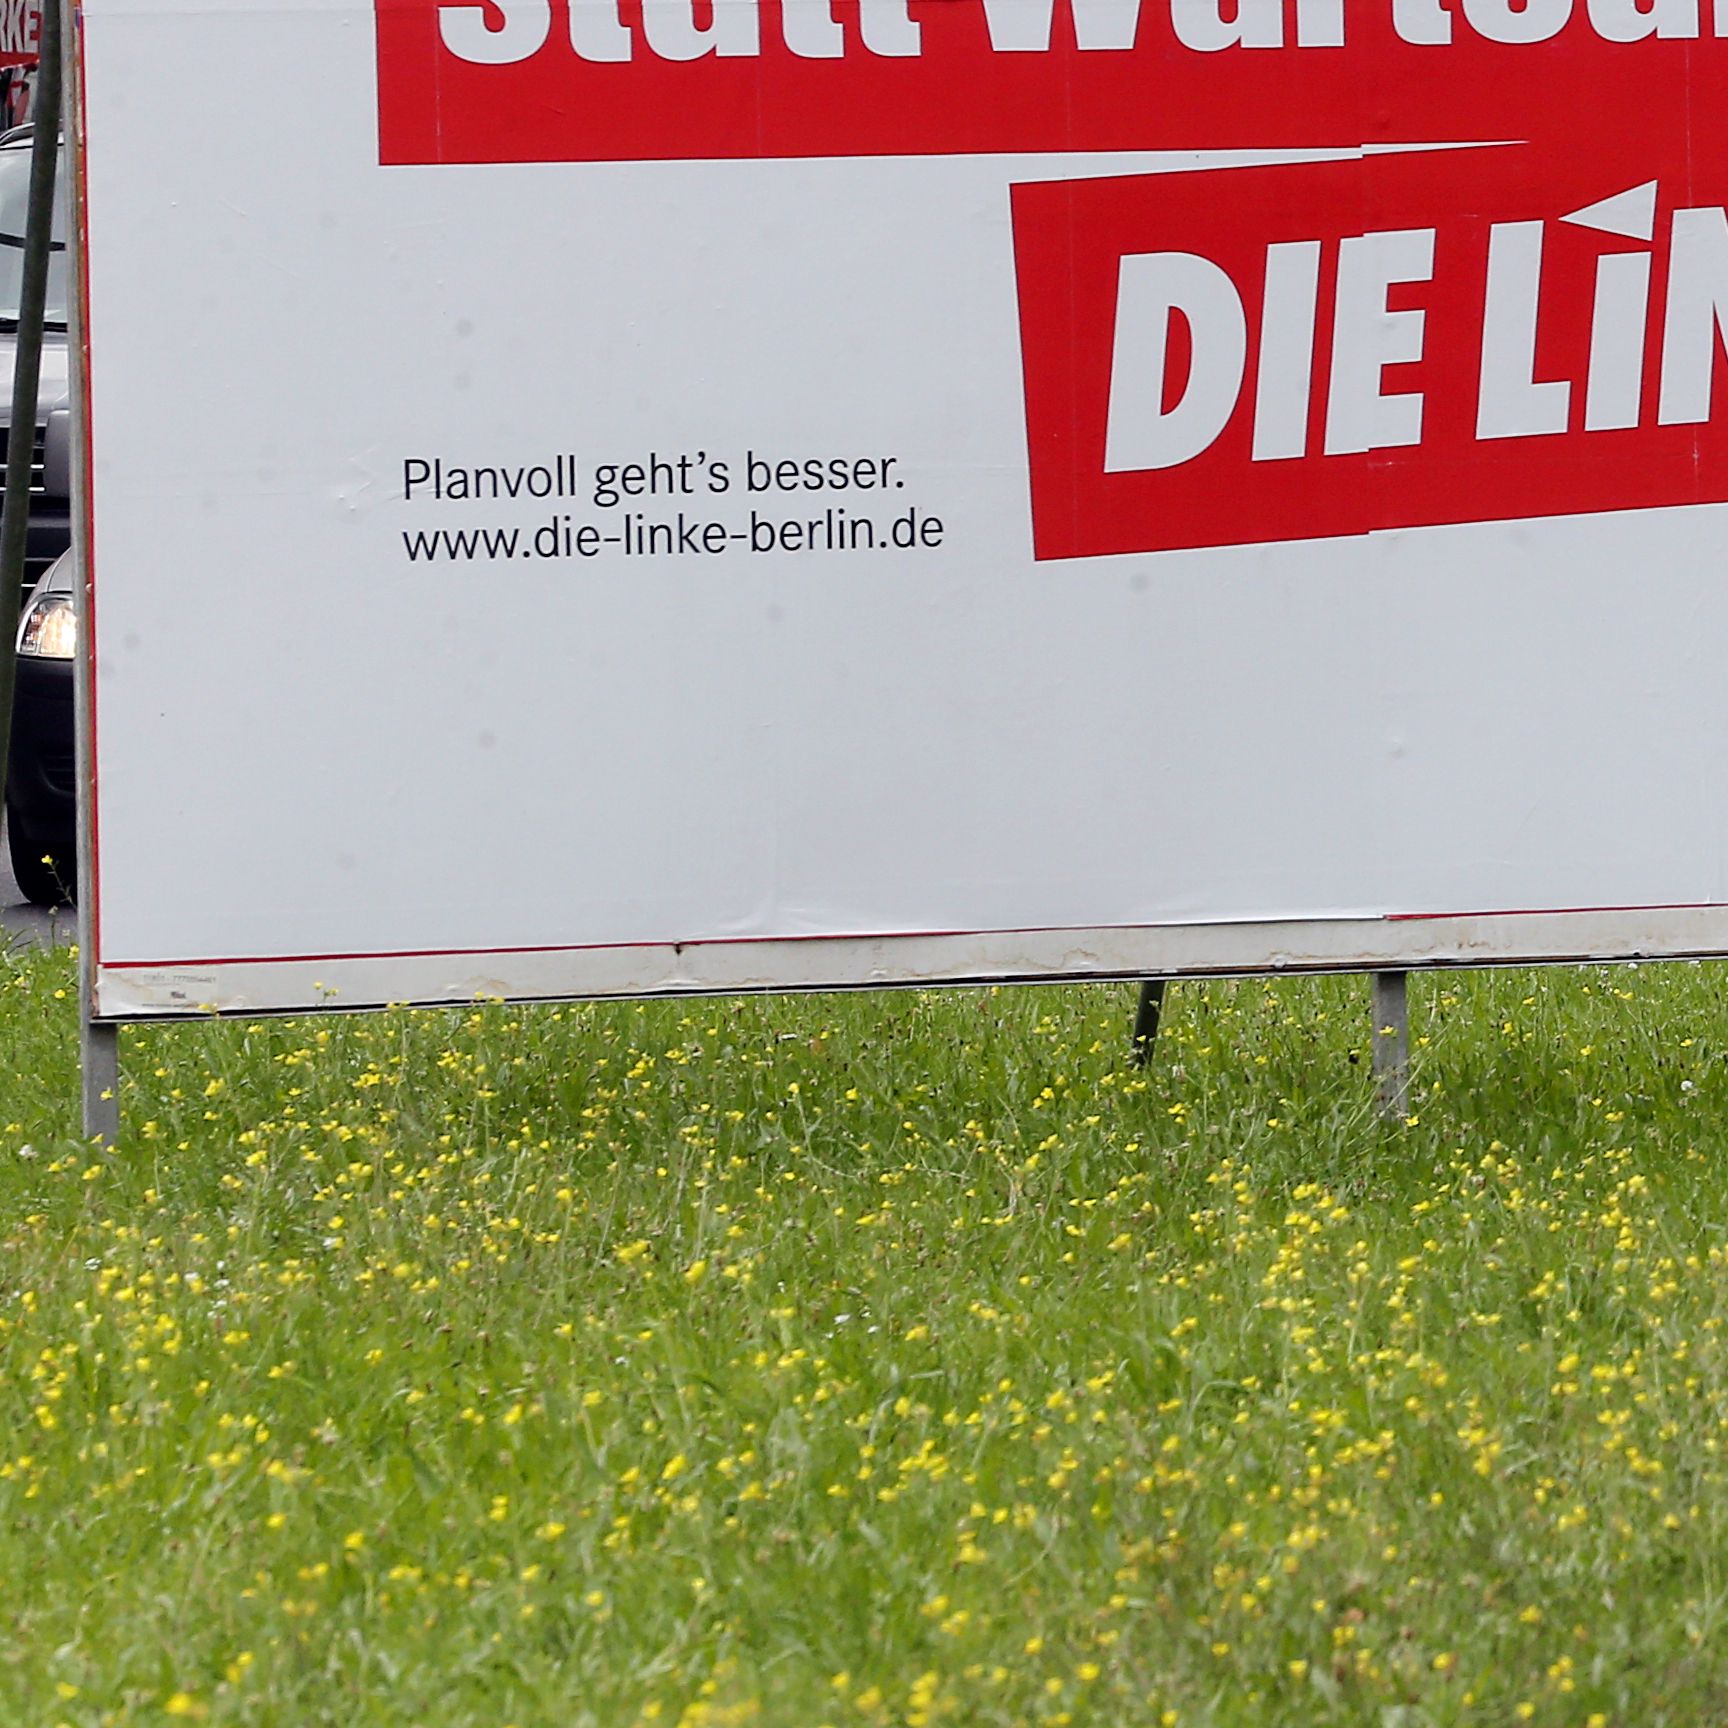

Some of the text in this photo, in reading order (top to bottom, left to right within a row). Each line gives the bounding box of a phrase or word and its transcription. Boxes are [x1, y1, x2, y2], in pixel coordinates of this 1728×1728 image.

[1103, 228, 1435, 473] DIE
[403, 450, 904, 507] Planvoll geht’s besser.
[402, 507, 944, 561] www.die-linke-berlin.de
